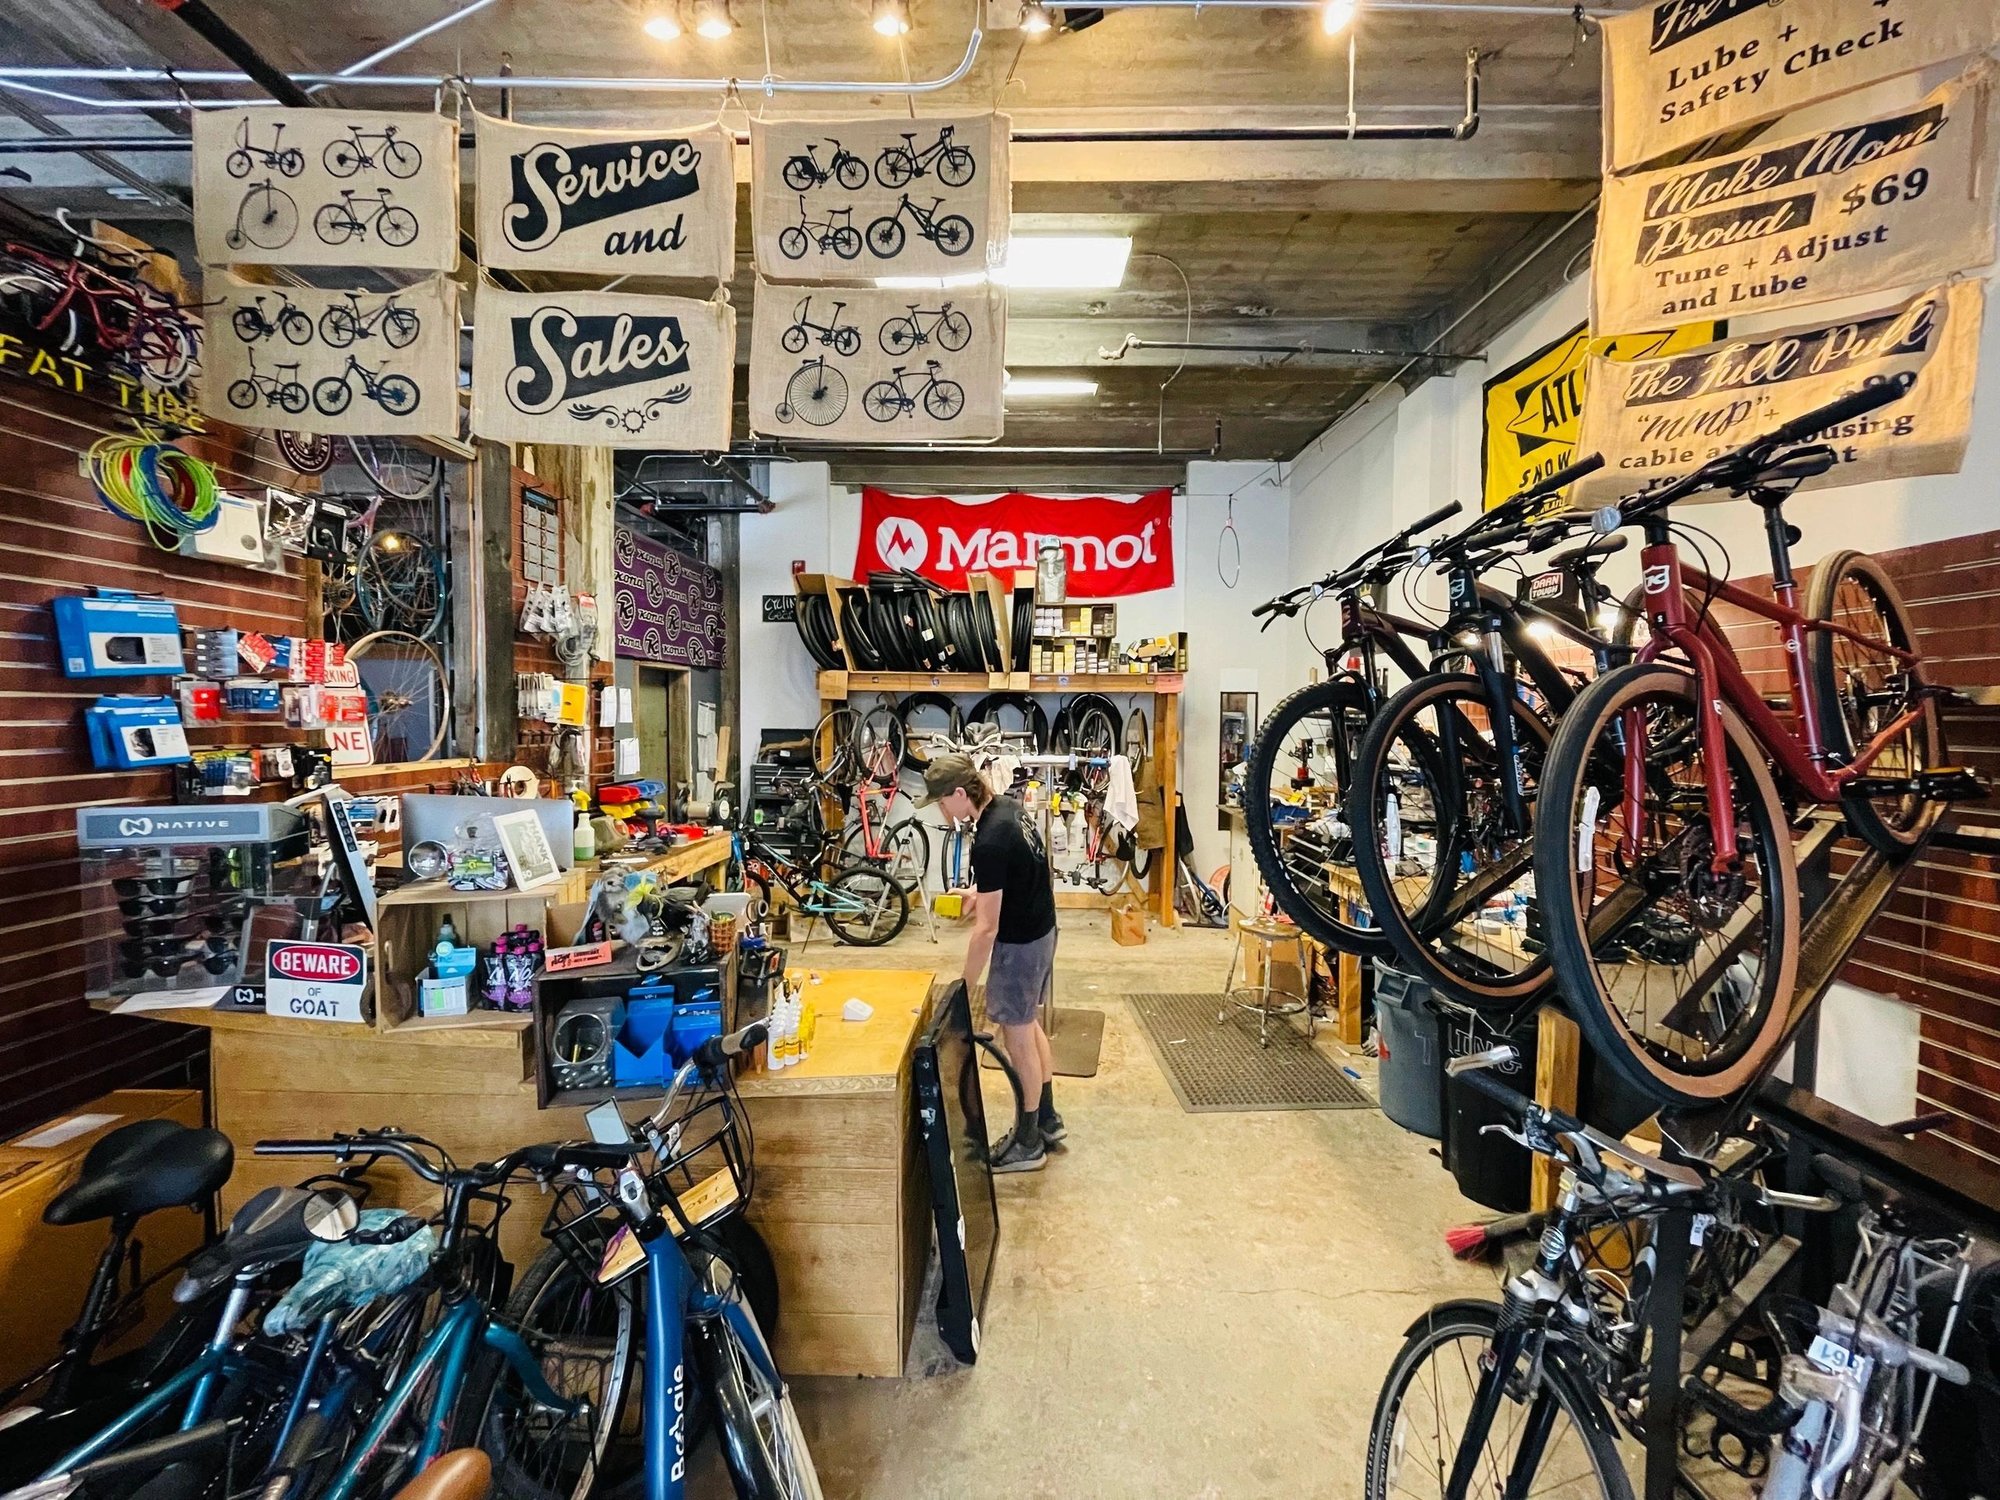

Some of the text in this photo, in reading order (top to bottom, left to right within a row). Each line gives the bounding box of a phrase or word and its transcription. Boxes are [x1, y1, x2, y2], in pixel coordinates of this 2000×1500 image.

[1659, 18, 1905, 124] Safety Check
[1666, 39, 1760, 92] Lube
[1648, 115, 1949, 218] Make Mom
[1839, 167, 1930, 216] $69
[503, 142, 701, 252] Service
[604, 213, 688, 256] and
[1641, 200, 1796, 267] Proud
[1655, 262, 1730, 289] Tune
[1769, 224, 1890, 262] Adjust
[1661, 274, 1808, 315] and Lube
[505, 306, 691, 414] Sales
[1687, 339, 1801, 400] Full
[1809, 300, 1936, 375] Pull
[1541, 366, 1588, 433] ATL
[1619, 447, 1695, 469] cable
[156, 820, 230, 830] NATIVE
[280, 951, 351, 976] BEWARE
[289, 999, 340, 1018] GOAT
[307, 987, 321, 997] OF
